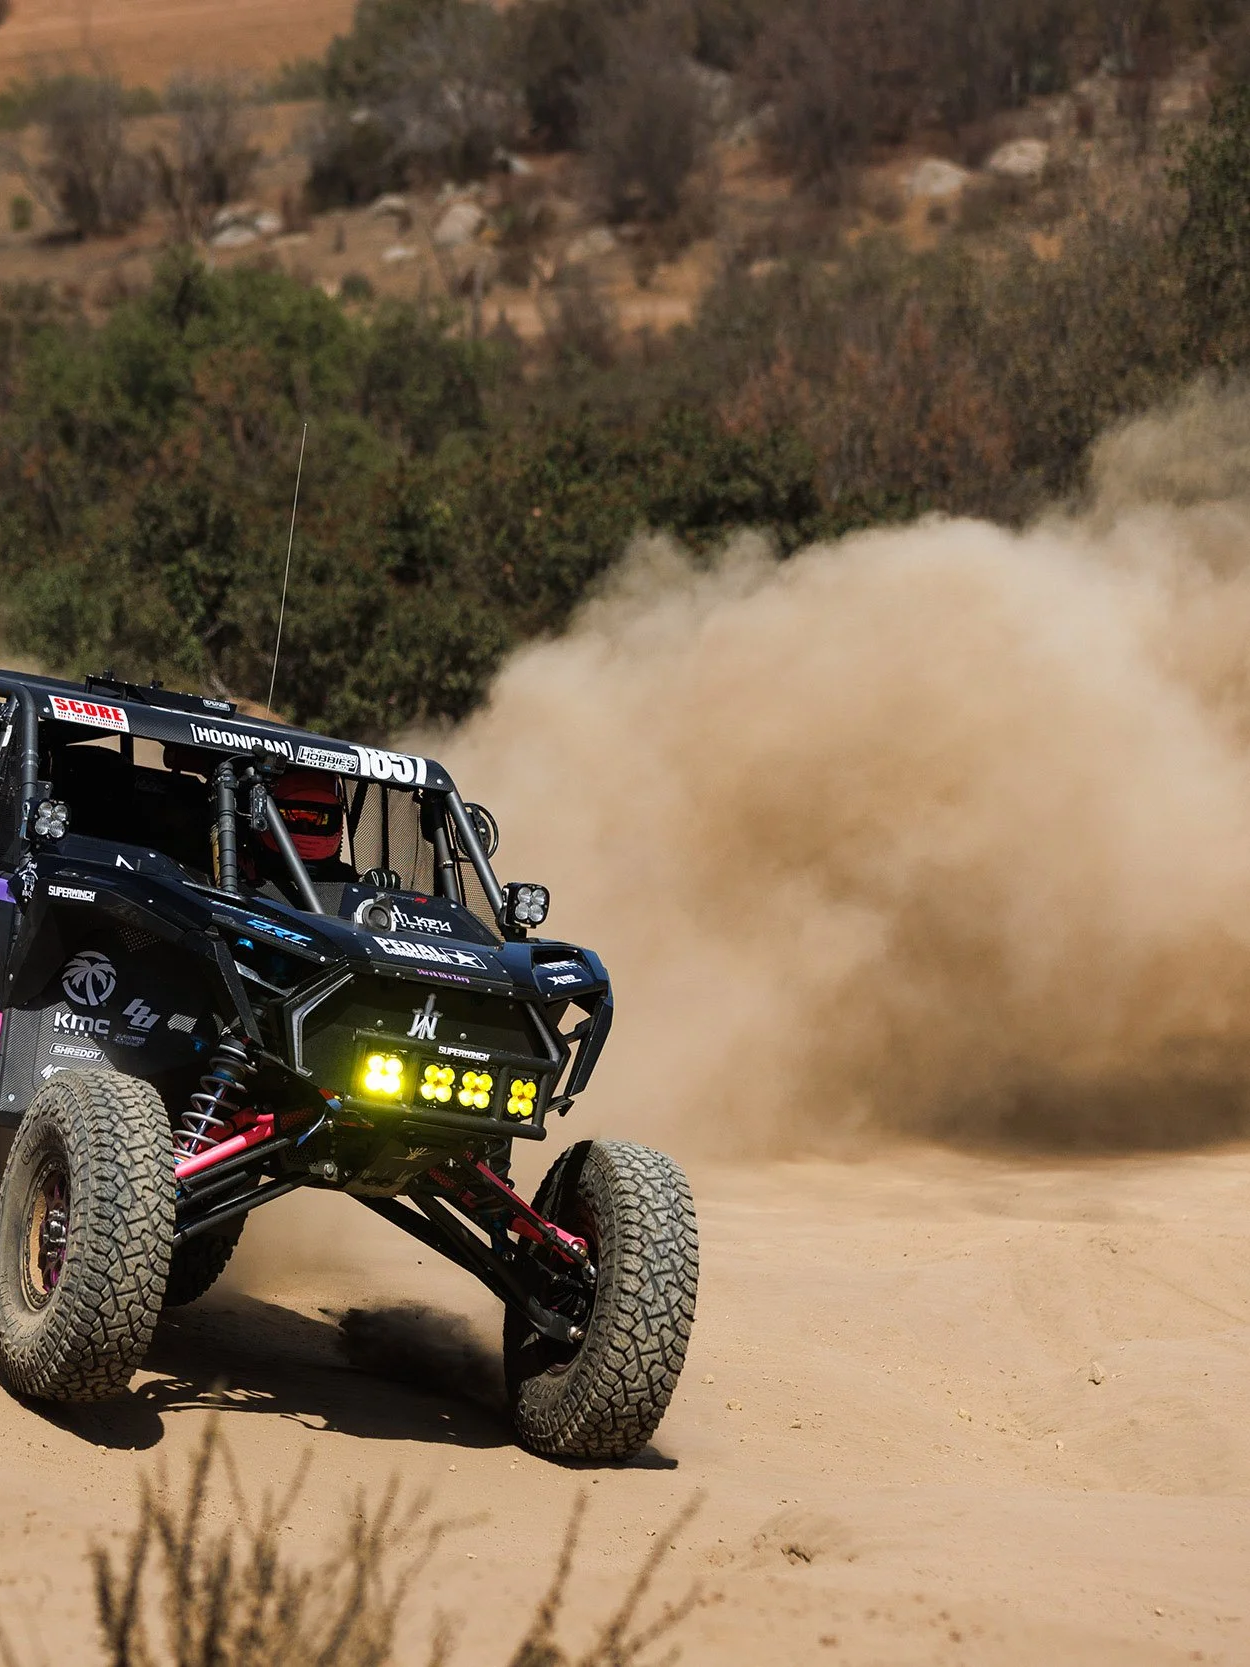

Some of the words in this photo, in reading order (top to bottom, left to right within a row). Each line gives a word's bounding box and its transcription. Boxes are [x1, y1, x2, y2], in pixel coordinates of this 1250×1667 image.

[53, 697, 124, 722] SCORE
[300, 748, 355, 768] HOBBIES
[349, 745, 427, 785] 1857
[48, 886, 96, 902] SUPERWINCH
[246, 919, 312, 942] DRT
[372, 936, 443, 956] PEDAL
[53, 1011, 110, 1034] KMC
[53, 1028, 108, 1041] WHEELS
[52, 1045, 102, 1061] SHREDDY
[438, 1045, 490, 1062] SUPERWINCH
